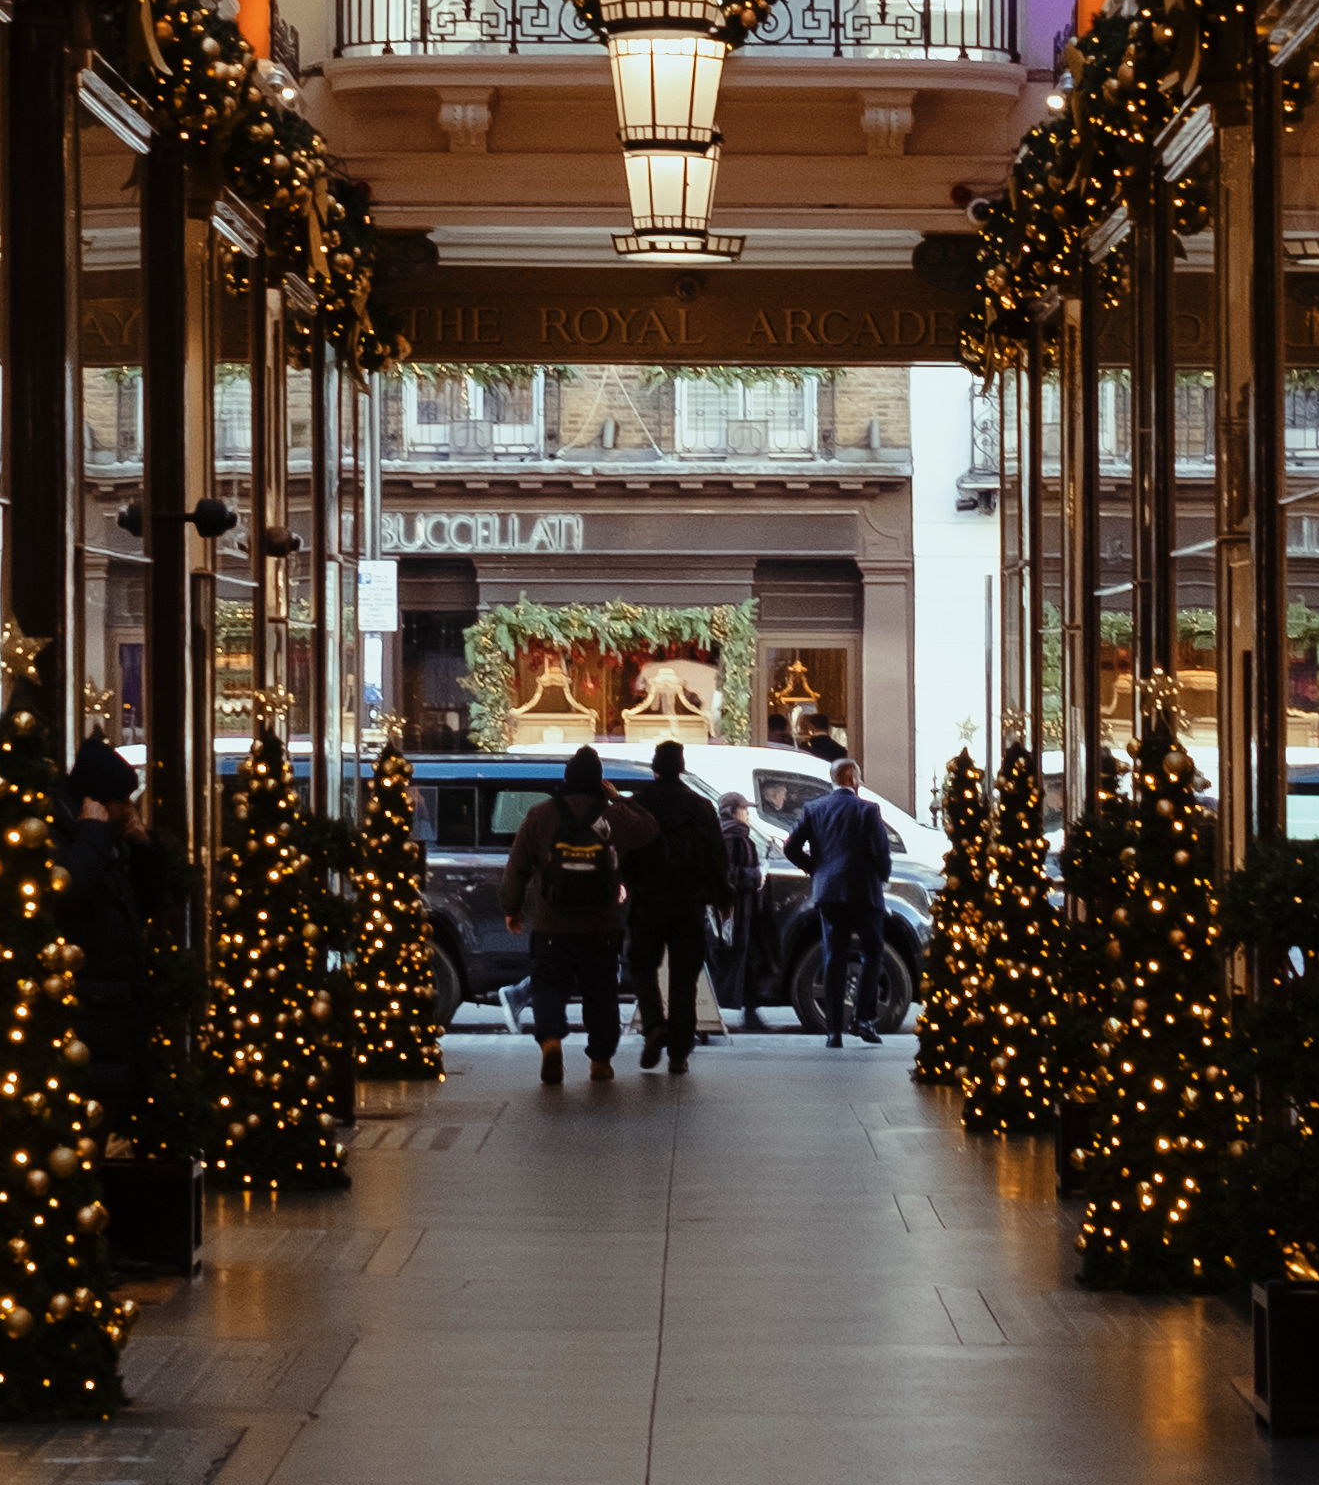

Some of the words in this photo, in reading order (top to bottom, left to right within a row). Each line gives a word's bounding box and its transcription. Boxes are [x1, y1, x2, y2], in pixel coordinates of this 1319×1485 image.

[402, 307, 502, 344] THE
[540, 306, 706, 345] ROYAL
[745, 308, 960, 347] ARCADE
[381, 512, 583, 552] BUCCELLATI
